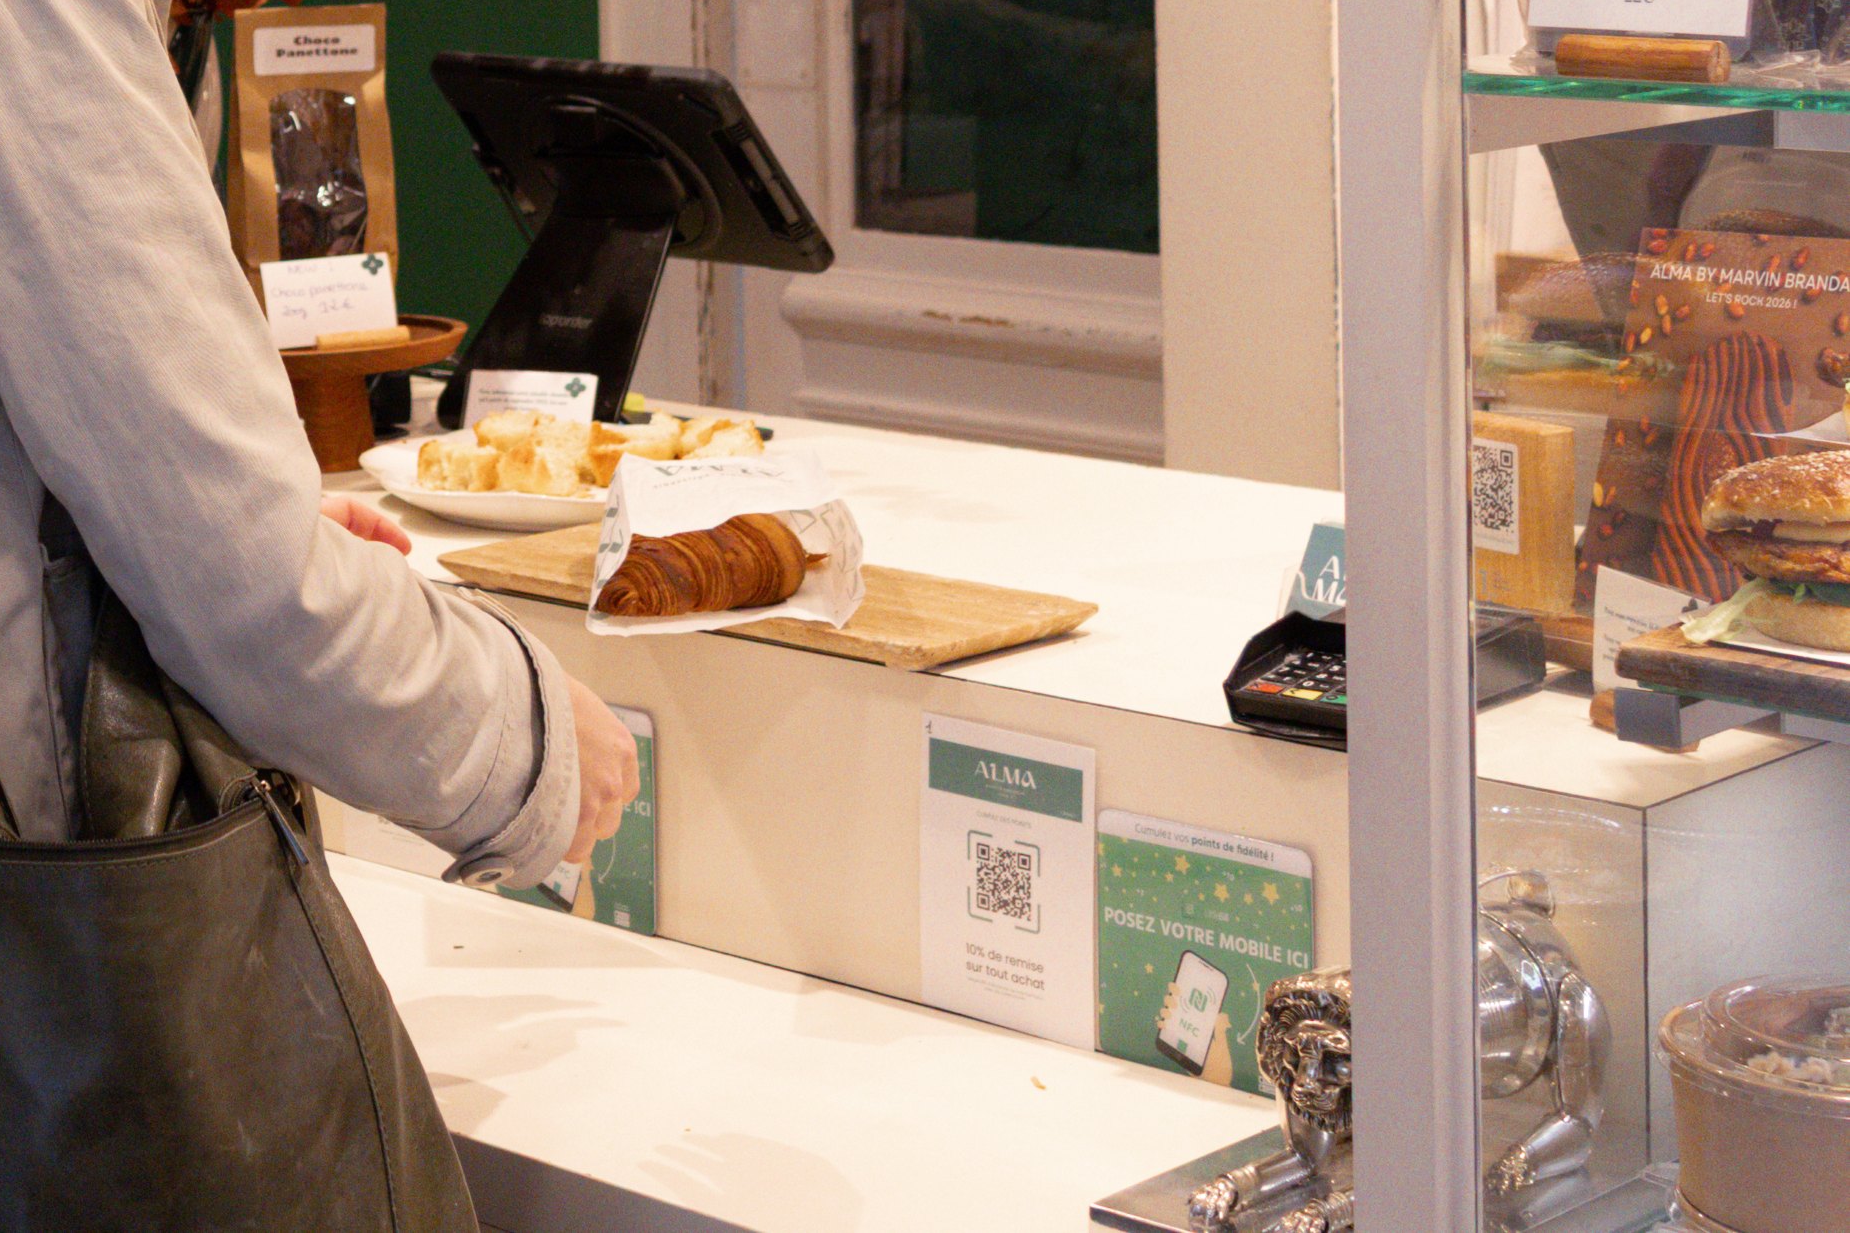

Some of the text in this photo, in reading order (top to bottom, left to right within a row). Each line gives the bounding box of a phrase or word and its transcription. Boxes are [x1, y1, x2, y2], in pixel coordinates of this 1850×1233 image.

[276, 48, 357, 58] Panettone
[294, 35, 340, 45] Choco
[1650, 264, 1692, 281] ALMA
[1696, 267, 1718, 282] BY
[1719, 268, 1781, 288] MARVIN
[1706, 292, 1732, 304] LET'S
[1734, 294, 1764, 307] ROCK
[1766, 297, 1791, 309] 2026
[974, 760, 1037, 790] ALMA
[1134, 823, 1172, 840] Cumulez
[1174, 833, 1190, 844] vos
[1190, 836, 1220, 851] points
[1223, 841, 1235, 853] de
[1236, 844, 1269, 862] fidélité
[1104, 906, 1309, 969] POSEZ VOTRE MOBILE ICI
[966, 942, 1044, 973] 10% de remise
[966, 961, 982, 973] sur
[986, 965, 1009, 980] tout
[1011, 973, 1045, 990] achat
[1179, 1018, 1200, 1038] NFC
